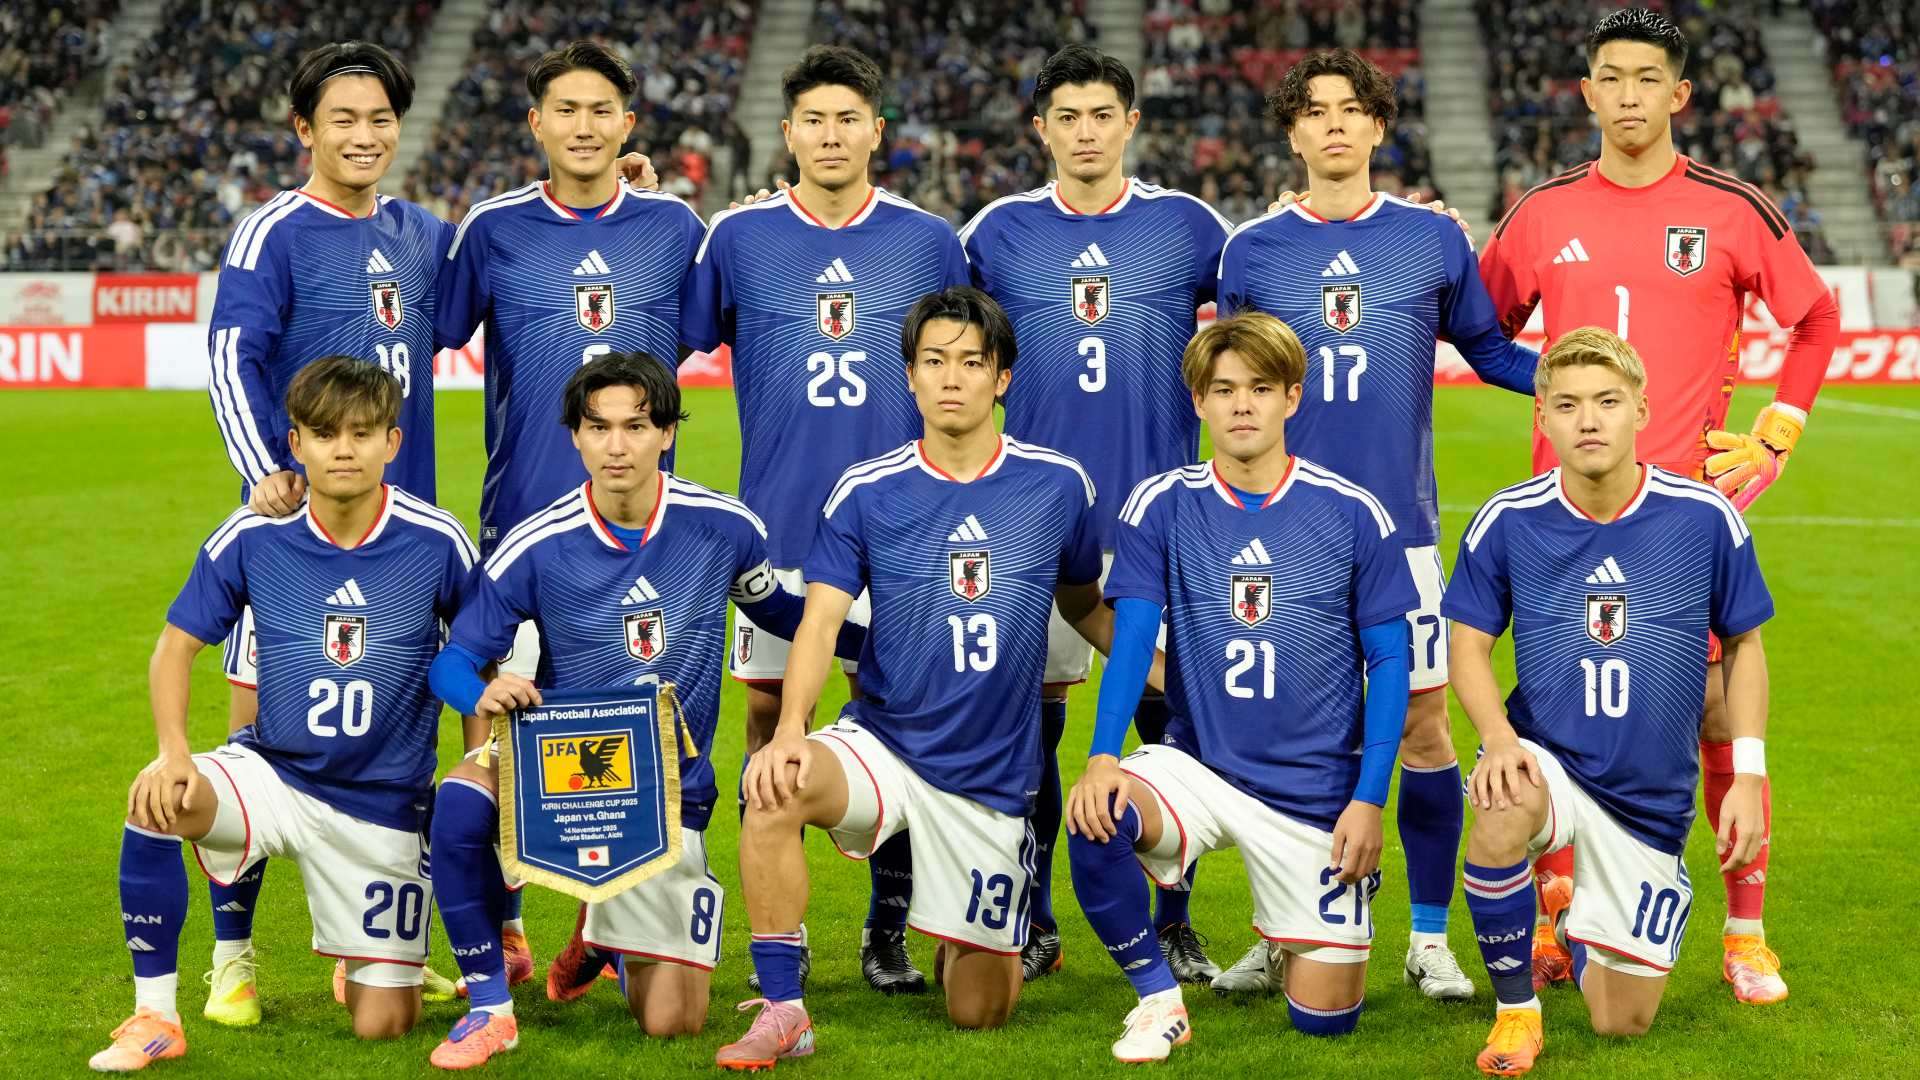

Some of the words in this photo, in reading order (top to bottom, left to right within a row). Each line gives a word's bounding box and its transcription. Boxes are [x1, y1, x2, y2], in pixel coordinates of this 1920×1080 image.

[97, 286, 193, 316] KIRIN
[1083, 309, 1100, 317] JFA
[1615, 285, 1630, 341] 1
[807, 351, 867, 407] 25
[1078, 336, 1107, 393] 3
[1320, 345, 1367, 402] 17
[745, 571, 769, 597] C
[632, 612, 653, 620] JAPAN
[1242, 610, 1260, 618] JFA
[335, 650, 353, 658] JFA
[948, 613, 997, 673] 13
[1225, 640, 1276, 699] 21
[1580, 658, 1630, 718] 10
[307, 678, 374, 738] 20
[521, 711, 548, 723] Japan
[549, 708, 590, 721] Football
[592, 705, 647, 718] Association
[545, 742, 577, 757] JFA
[541, 802, 561, 811] KIRIN
[562, 800, 604, 810] CHALLENGE
[605, 799, 620, 807] CUP
[621, 798, 638, 806] 2025
[554, 813, 582, 824] Japan
[571, 826, 602, 834] November
[875, 867, 913, 880] JAPA
[363, 880, 424, 941] 20
[965, 868, 1014, 930] 13
[1318, 866, 1363, 925] 21
[122, 912, 162, 925] PAN
[690, 887, 716, 945] 8
[1631, 880, 1681, 945] 10
[1477, 927, 1526, 944] APAN
